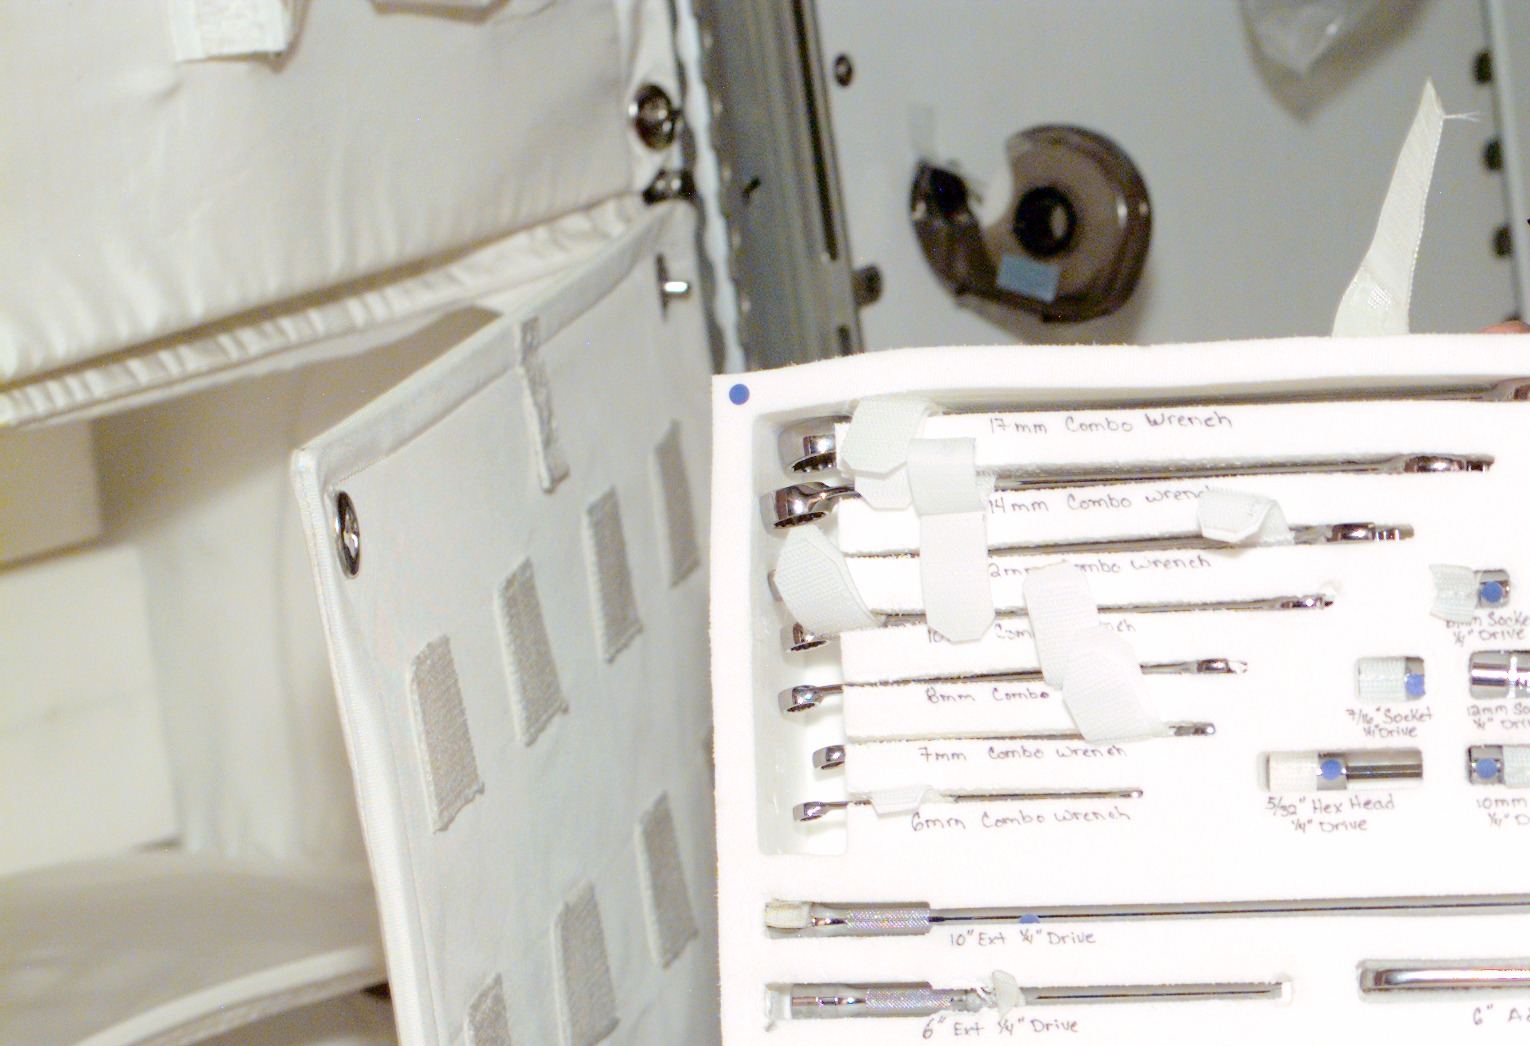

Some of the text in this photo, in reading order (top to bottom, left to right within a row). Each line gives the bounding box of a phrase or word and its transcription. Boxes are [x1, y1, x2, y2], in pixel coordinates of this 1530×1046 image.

[990, 417, 1047, 433] 17mm
[1062, 413, 1133, 433] Combo
[989, 497, 1048, 514] 14mm
[1067, 492, 1131, 510] Combo
[1478, 627, 1526, 641] Drive
[925, 687, 1049, 704] 8mm Combo
[1383, 706, 1432, 725] Socket
[1466, 704, 1508, 717] 12mm
[1380, 726, 1418, 738] Drive
[918, 746, 966, 762] 7mm
[988, 745, 1043, 760] Combo
[1312, 798, 1342, 814] Hex
[1349, 793, 1395, 810] Head
[1476, 797, 1527, 810] 10mm
[911, 811, 966, 832] 6mm
[981, 809, 1045, 828] Combo
[1318, 819, 1367, 833] Drive
[978, 931, 1006, 946] Ext
[1046, 931, 1096, 945] Drive
[953, 1021, 985, 1036] Ext
[1029, 1018, 1078, 1033] Drive
